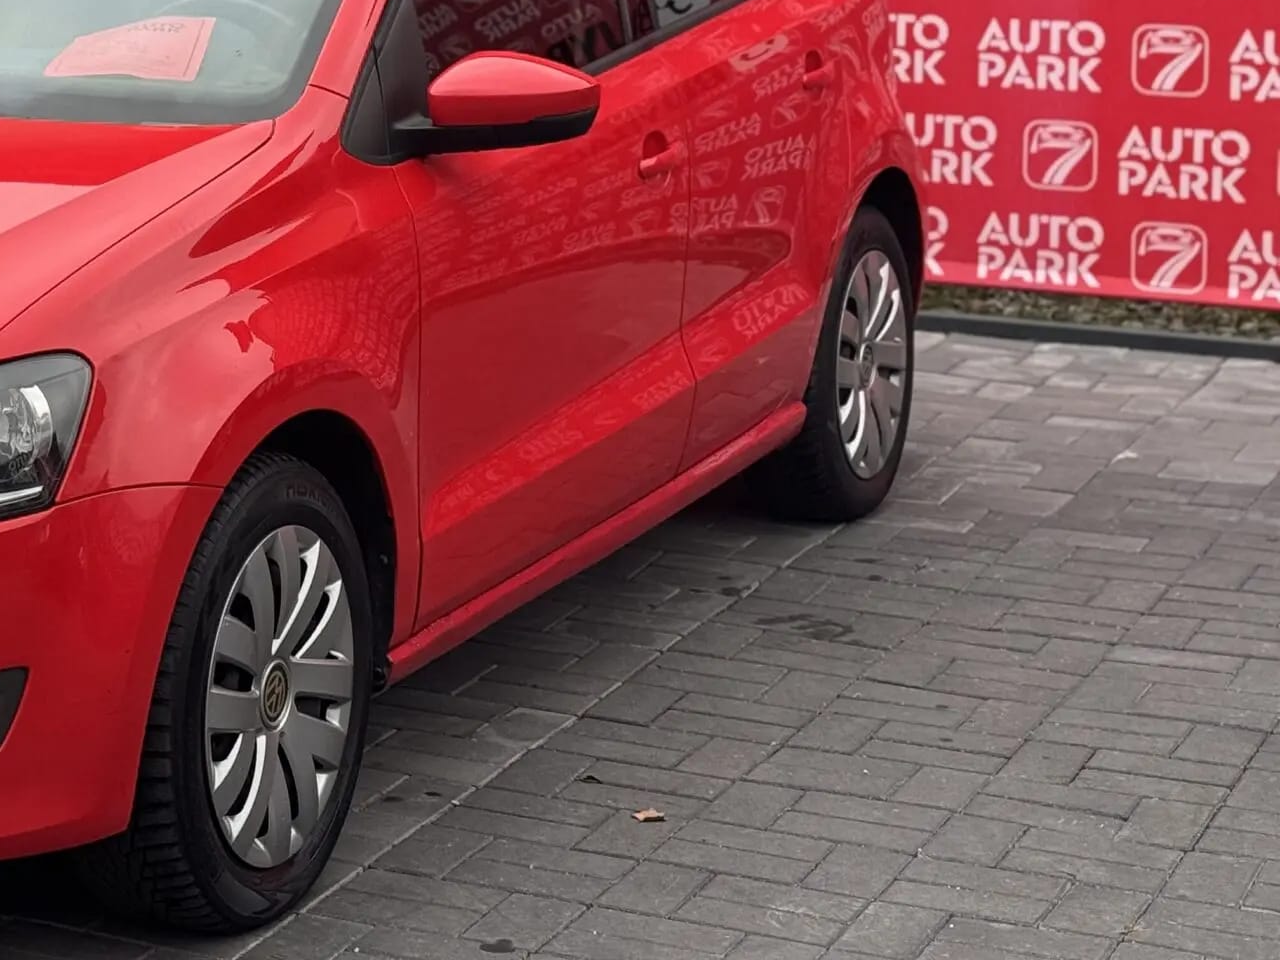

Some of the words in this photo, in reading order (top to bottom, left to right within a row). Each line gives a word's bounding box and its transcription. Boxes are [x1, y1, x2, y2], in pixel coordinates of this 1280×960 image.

[978, 19, 1105, 56] AUTO
[978, 52, 1100, 92] PARK
[1118, 126, 1250, 166] AUTO
[1119, 160, 1245, 203] PARK
[977, 212, 1104, 252] AUTO
[976, 245, 1101, 289] PARK
